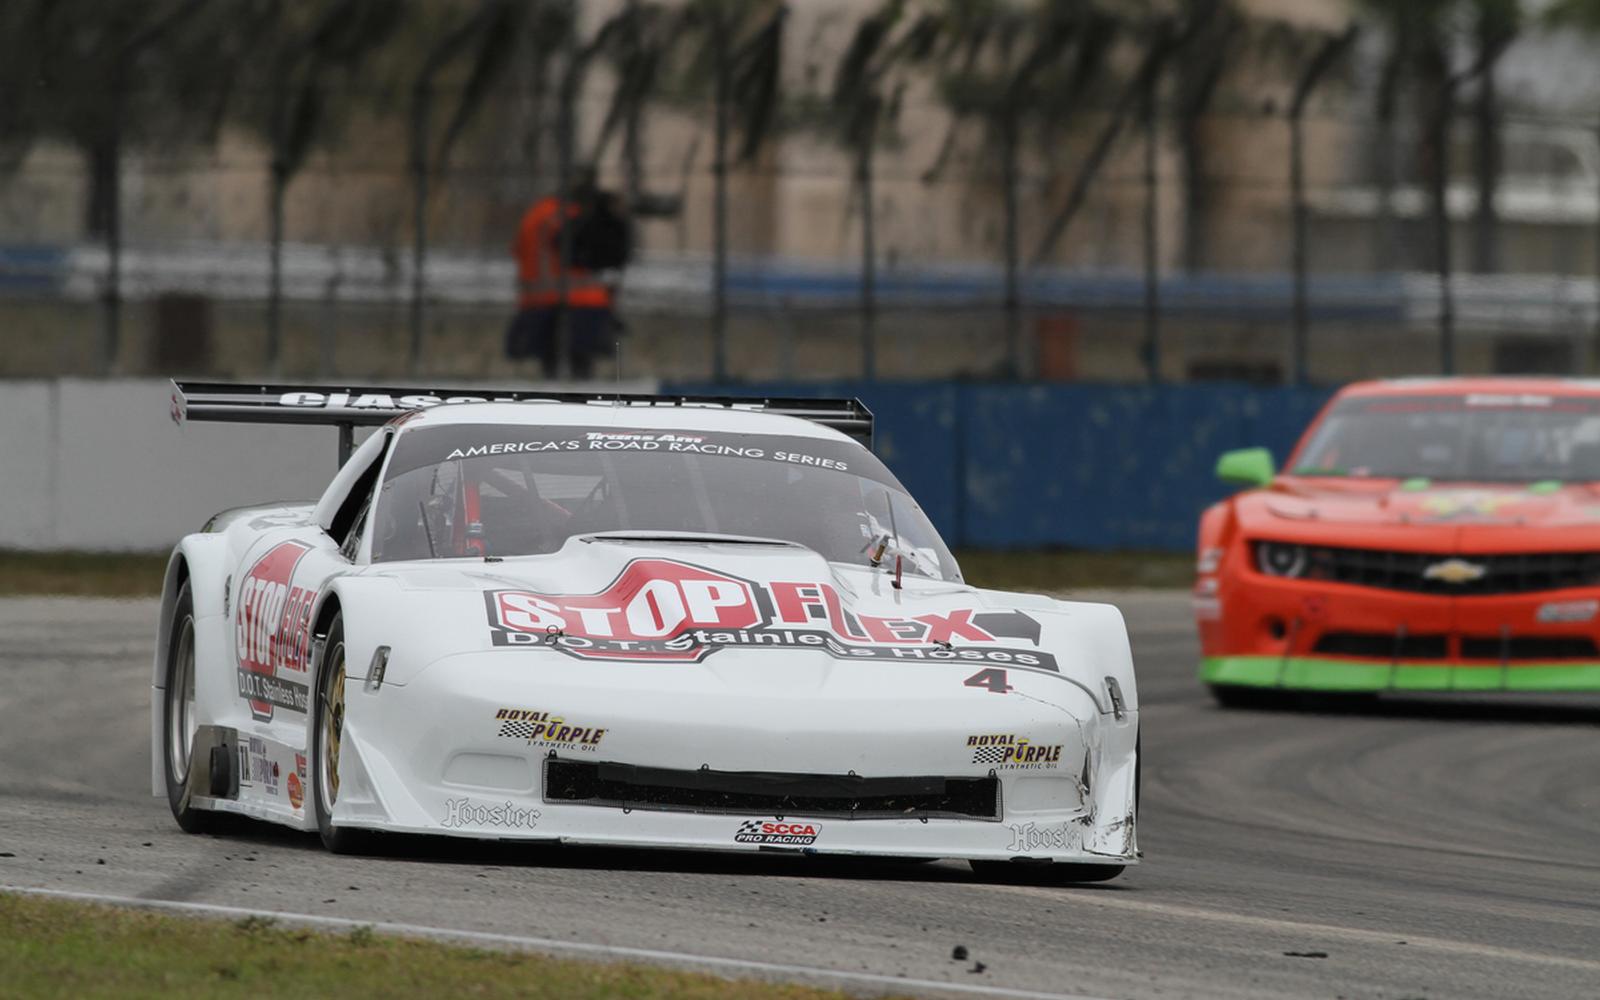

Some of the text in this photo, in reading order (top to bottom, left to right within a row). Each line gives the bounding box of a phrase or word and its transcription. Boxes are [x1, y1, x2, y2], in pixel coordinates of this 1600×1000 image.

[586, 432, 702, 443] Trans Am
[446, 440, 848, 471] AMERICA'S ROAD RACING SERIES
[238, 576, 288, 666] STOP
[502, 579, 996, 643] STOP FLEX
[508, 630, 1040, 665] D.O.T. Stainless Hoses
[963, 668, 1014, 695] 4
[496, 708, 549, 722] ROYAL
[531, 720, 605, 744] PURPLE
[967, 734, 1015, 746] ROYAL
[527, 740, 597, 752] SYNTHETIC OIL
[1003, 742, 1062, 762] PURPLE
[440, 798, 542, 829] Hoosier
[737, 833, 813, 845] PRO RACING
[762, 823, 817, 836] SCCA
[1006, 822, 1084, 852] Hoosi
